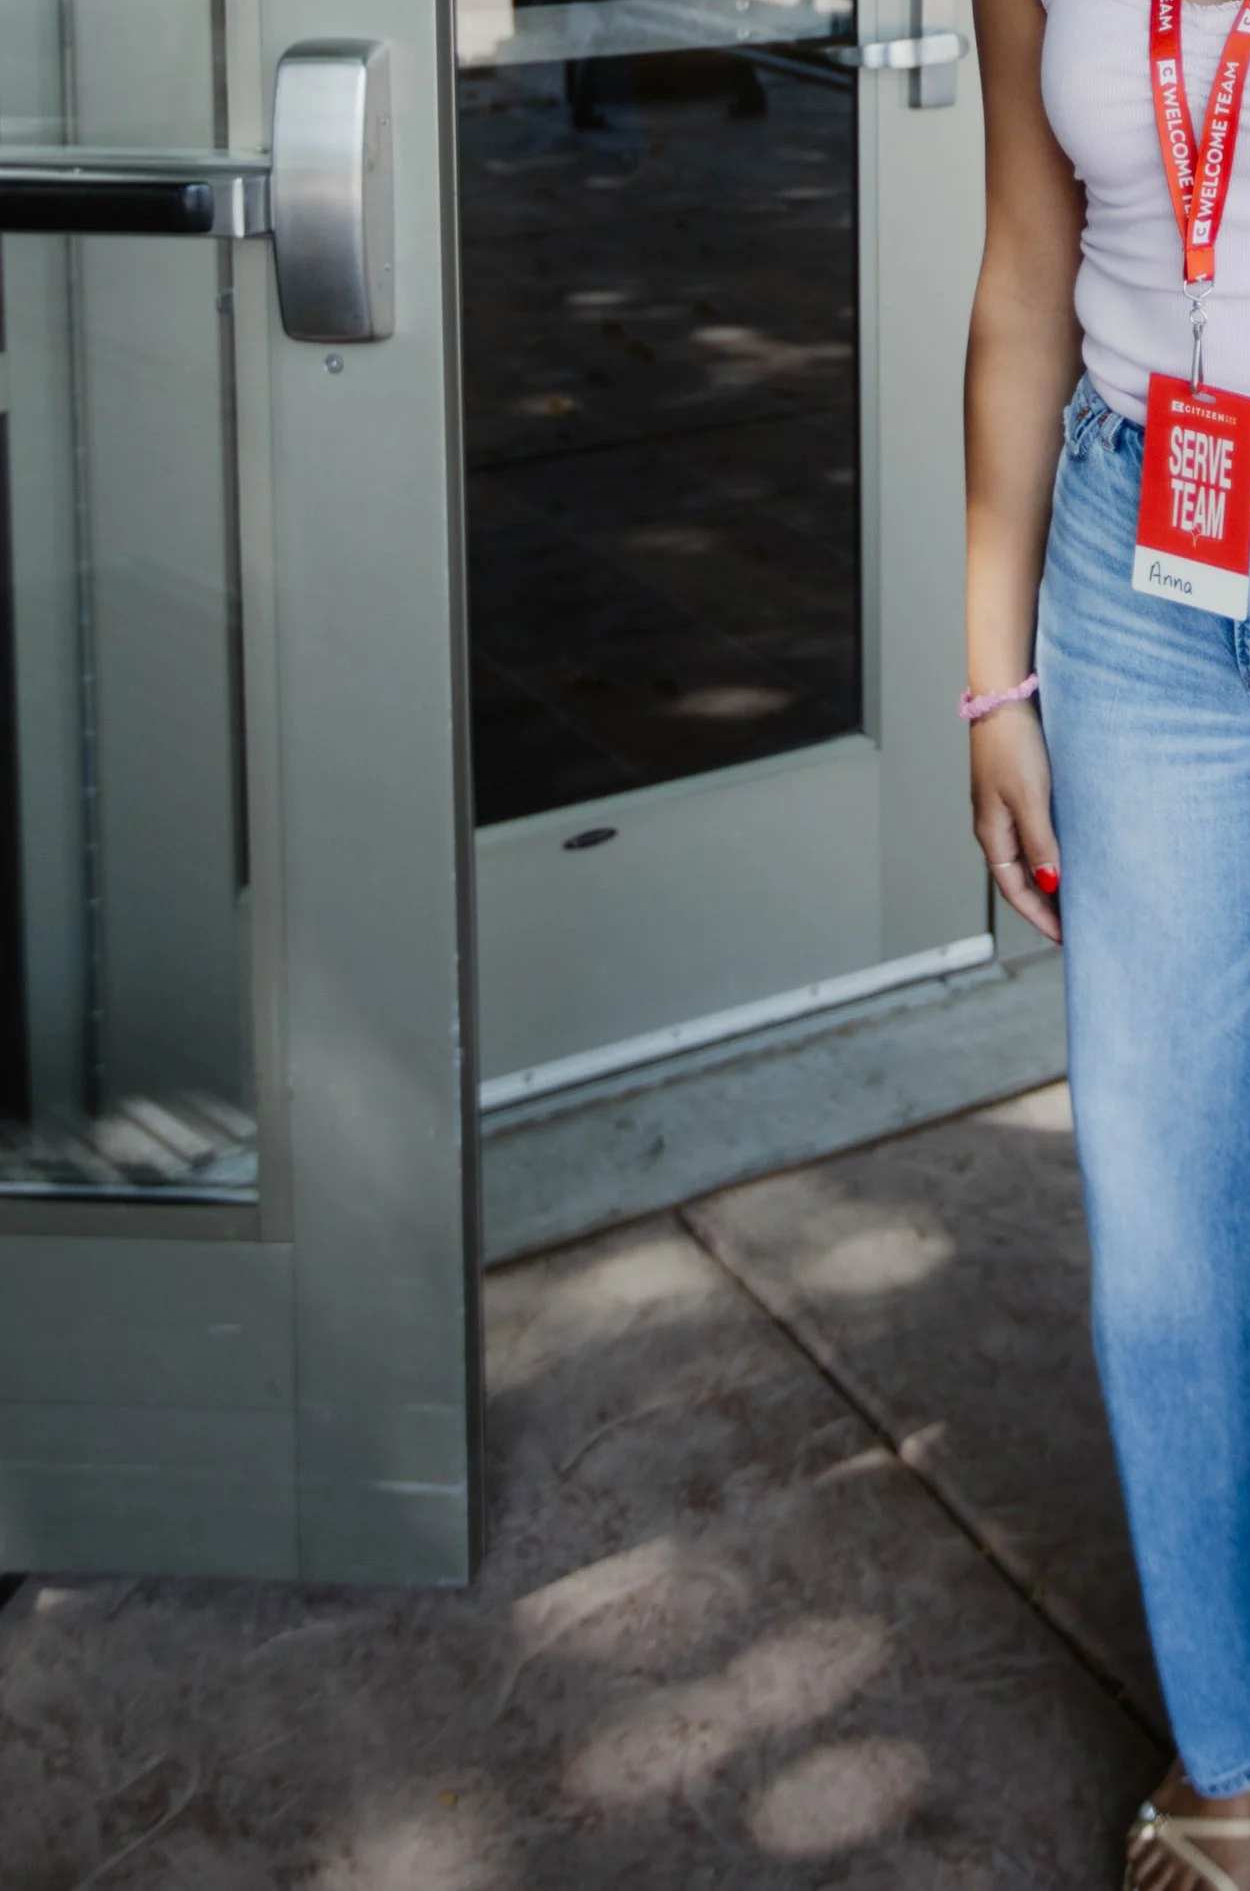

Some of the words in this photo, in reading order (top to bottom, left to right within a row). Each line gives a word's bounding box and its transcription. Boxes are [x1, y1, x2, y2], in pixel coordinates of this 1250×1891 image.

[1162, 86, 1195, 188] WELCOME
[1198, 119, 1229, 221] WELCOME
[1214, 61, 1240, 115] TEAM
[1184, 405, 1225, 422] CITIZEN
[1168, 425, 1235, 490] SERVE
[1170, 477, 1227, 540] TEAM
[1148, 561, 1194, 596] Anna
